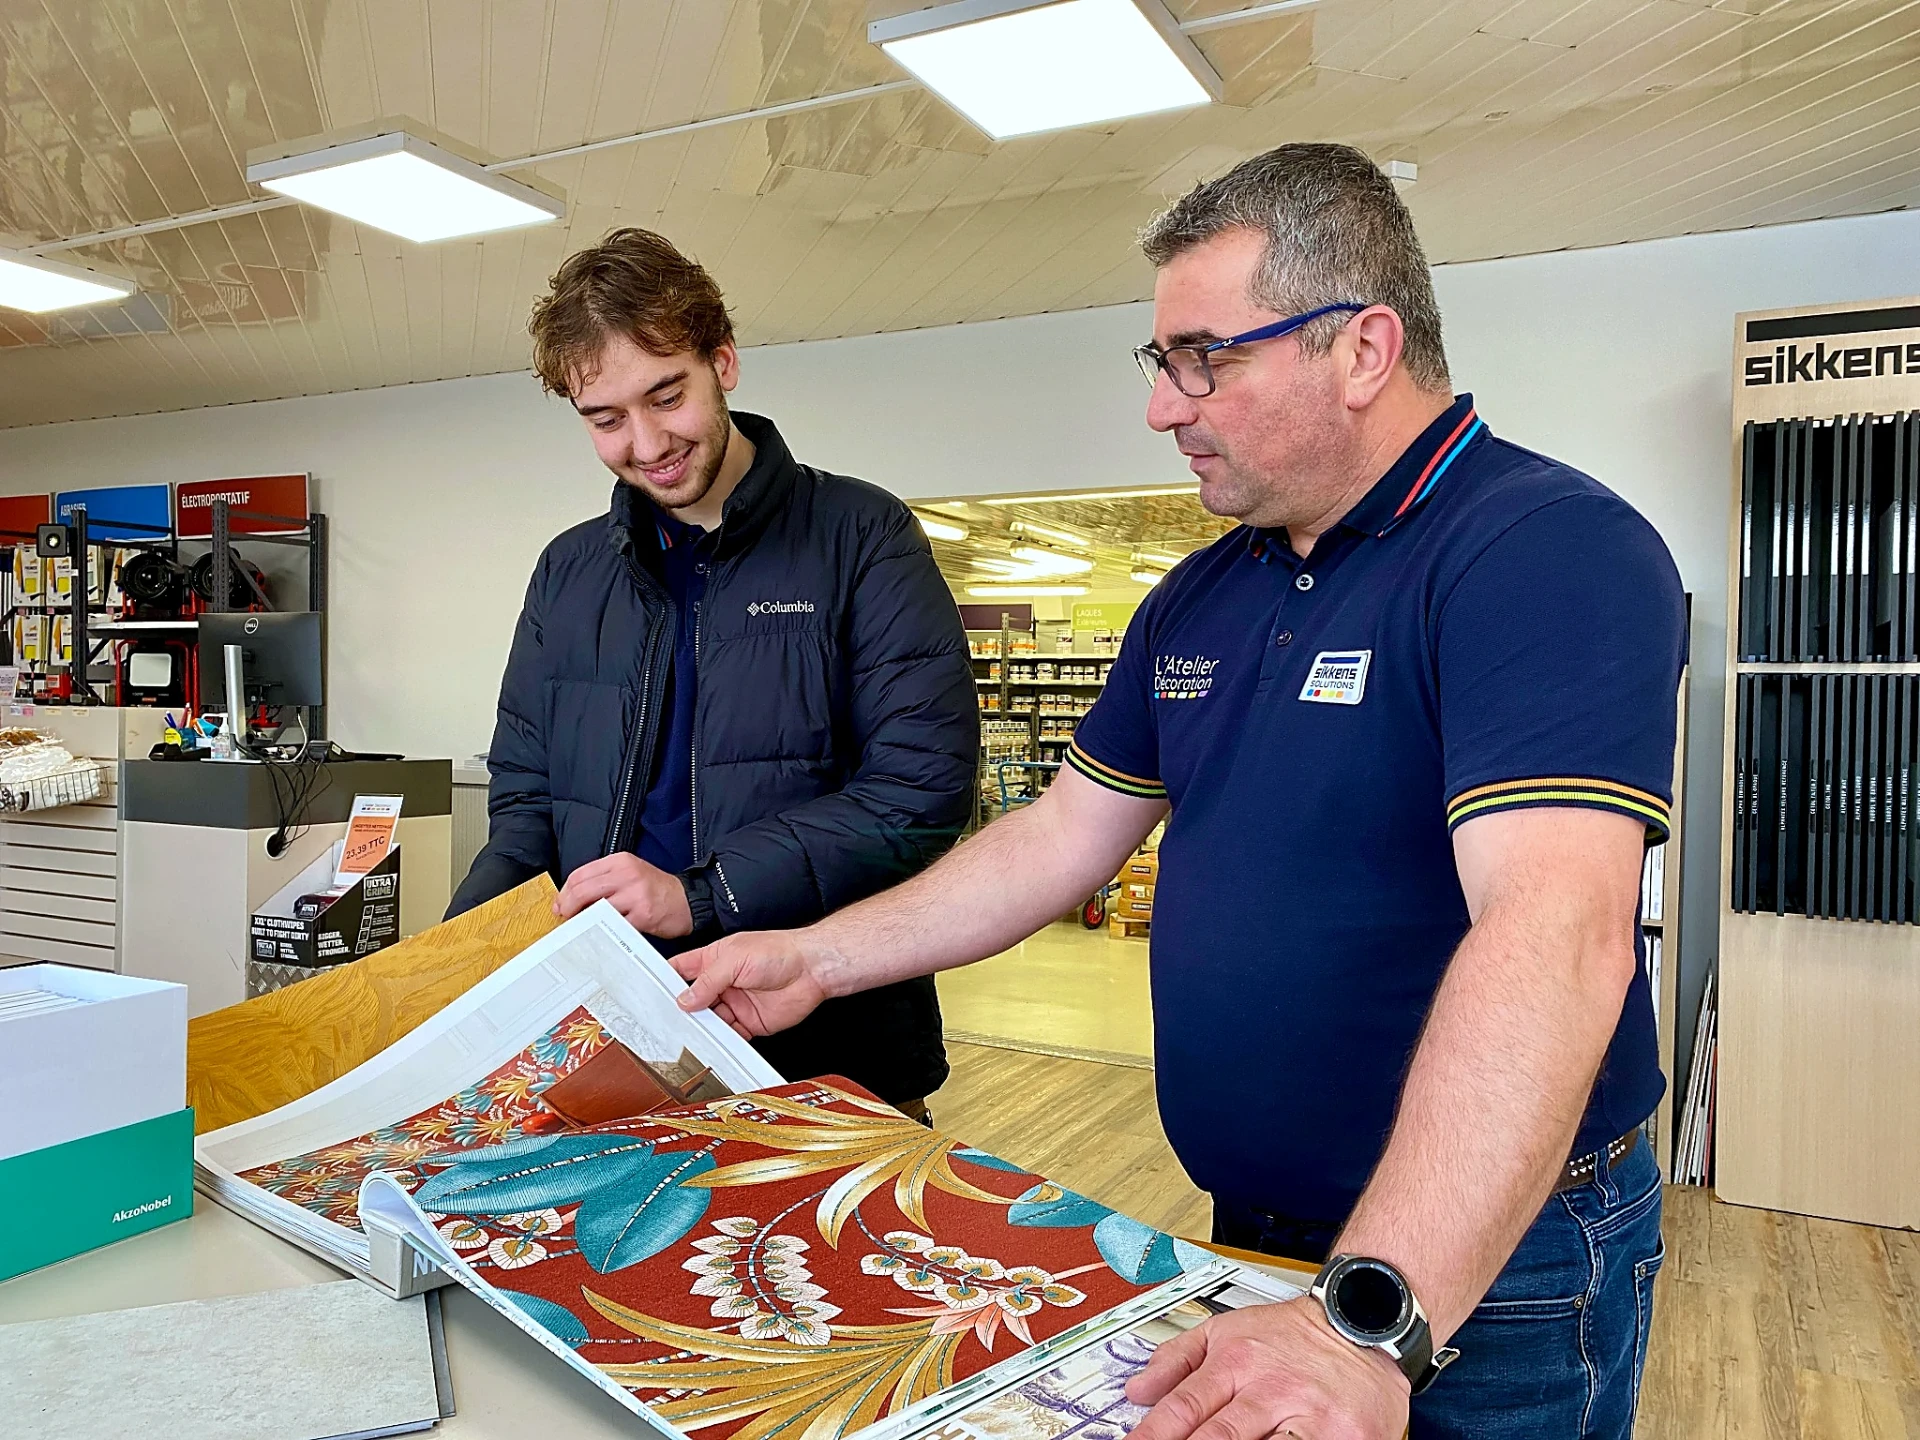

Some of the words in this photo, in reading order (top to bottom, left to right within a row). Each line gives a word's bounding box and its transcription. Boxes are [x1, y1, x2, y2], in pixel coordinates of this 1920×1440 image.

[1745, 342, 1920, 386] sikkens
[181, 490, 250, 508] ÉLECTROPORTATIF
[760, 600, 814, 613] Columbia
[1077, 609, 1102, 617] LAQUES
[1155, 655, 1220, 675] L'Atelier
[1313, 665, 1358, 679] sikkens
[1154, 675, 1213, 690] Décoration
[1310, 680, 1355, 689] SOLUTIONS
[346, 844, 367, 860] 23,39
[368, 836, 385, 849] TTC
[366, 877, 391, 887] ULTRA
[366, 886, 391, 897] GRIME
[266, 918, 305, 930] CLOTHWIPES
[251, 927, 266, 936] BUILT
[266, 929, 273, 937] TO
[274, 930, 291, 939] FIGHT
[291, 932, 309, 941] DIRTY
[318, 931, 342, 940] BIGGER.
[318, 939, 344, 948] WETTER.
[318, 946, 350, 957] STRONGER.
[112, 1194, 172, 1223] AkzoNobel
